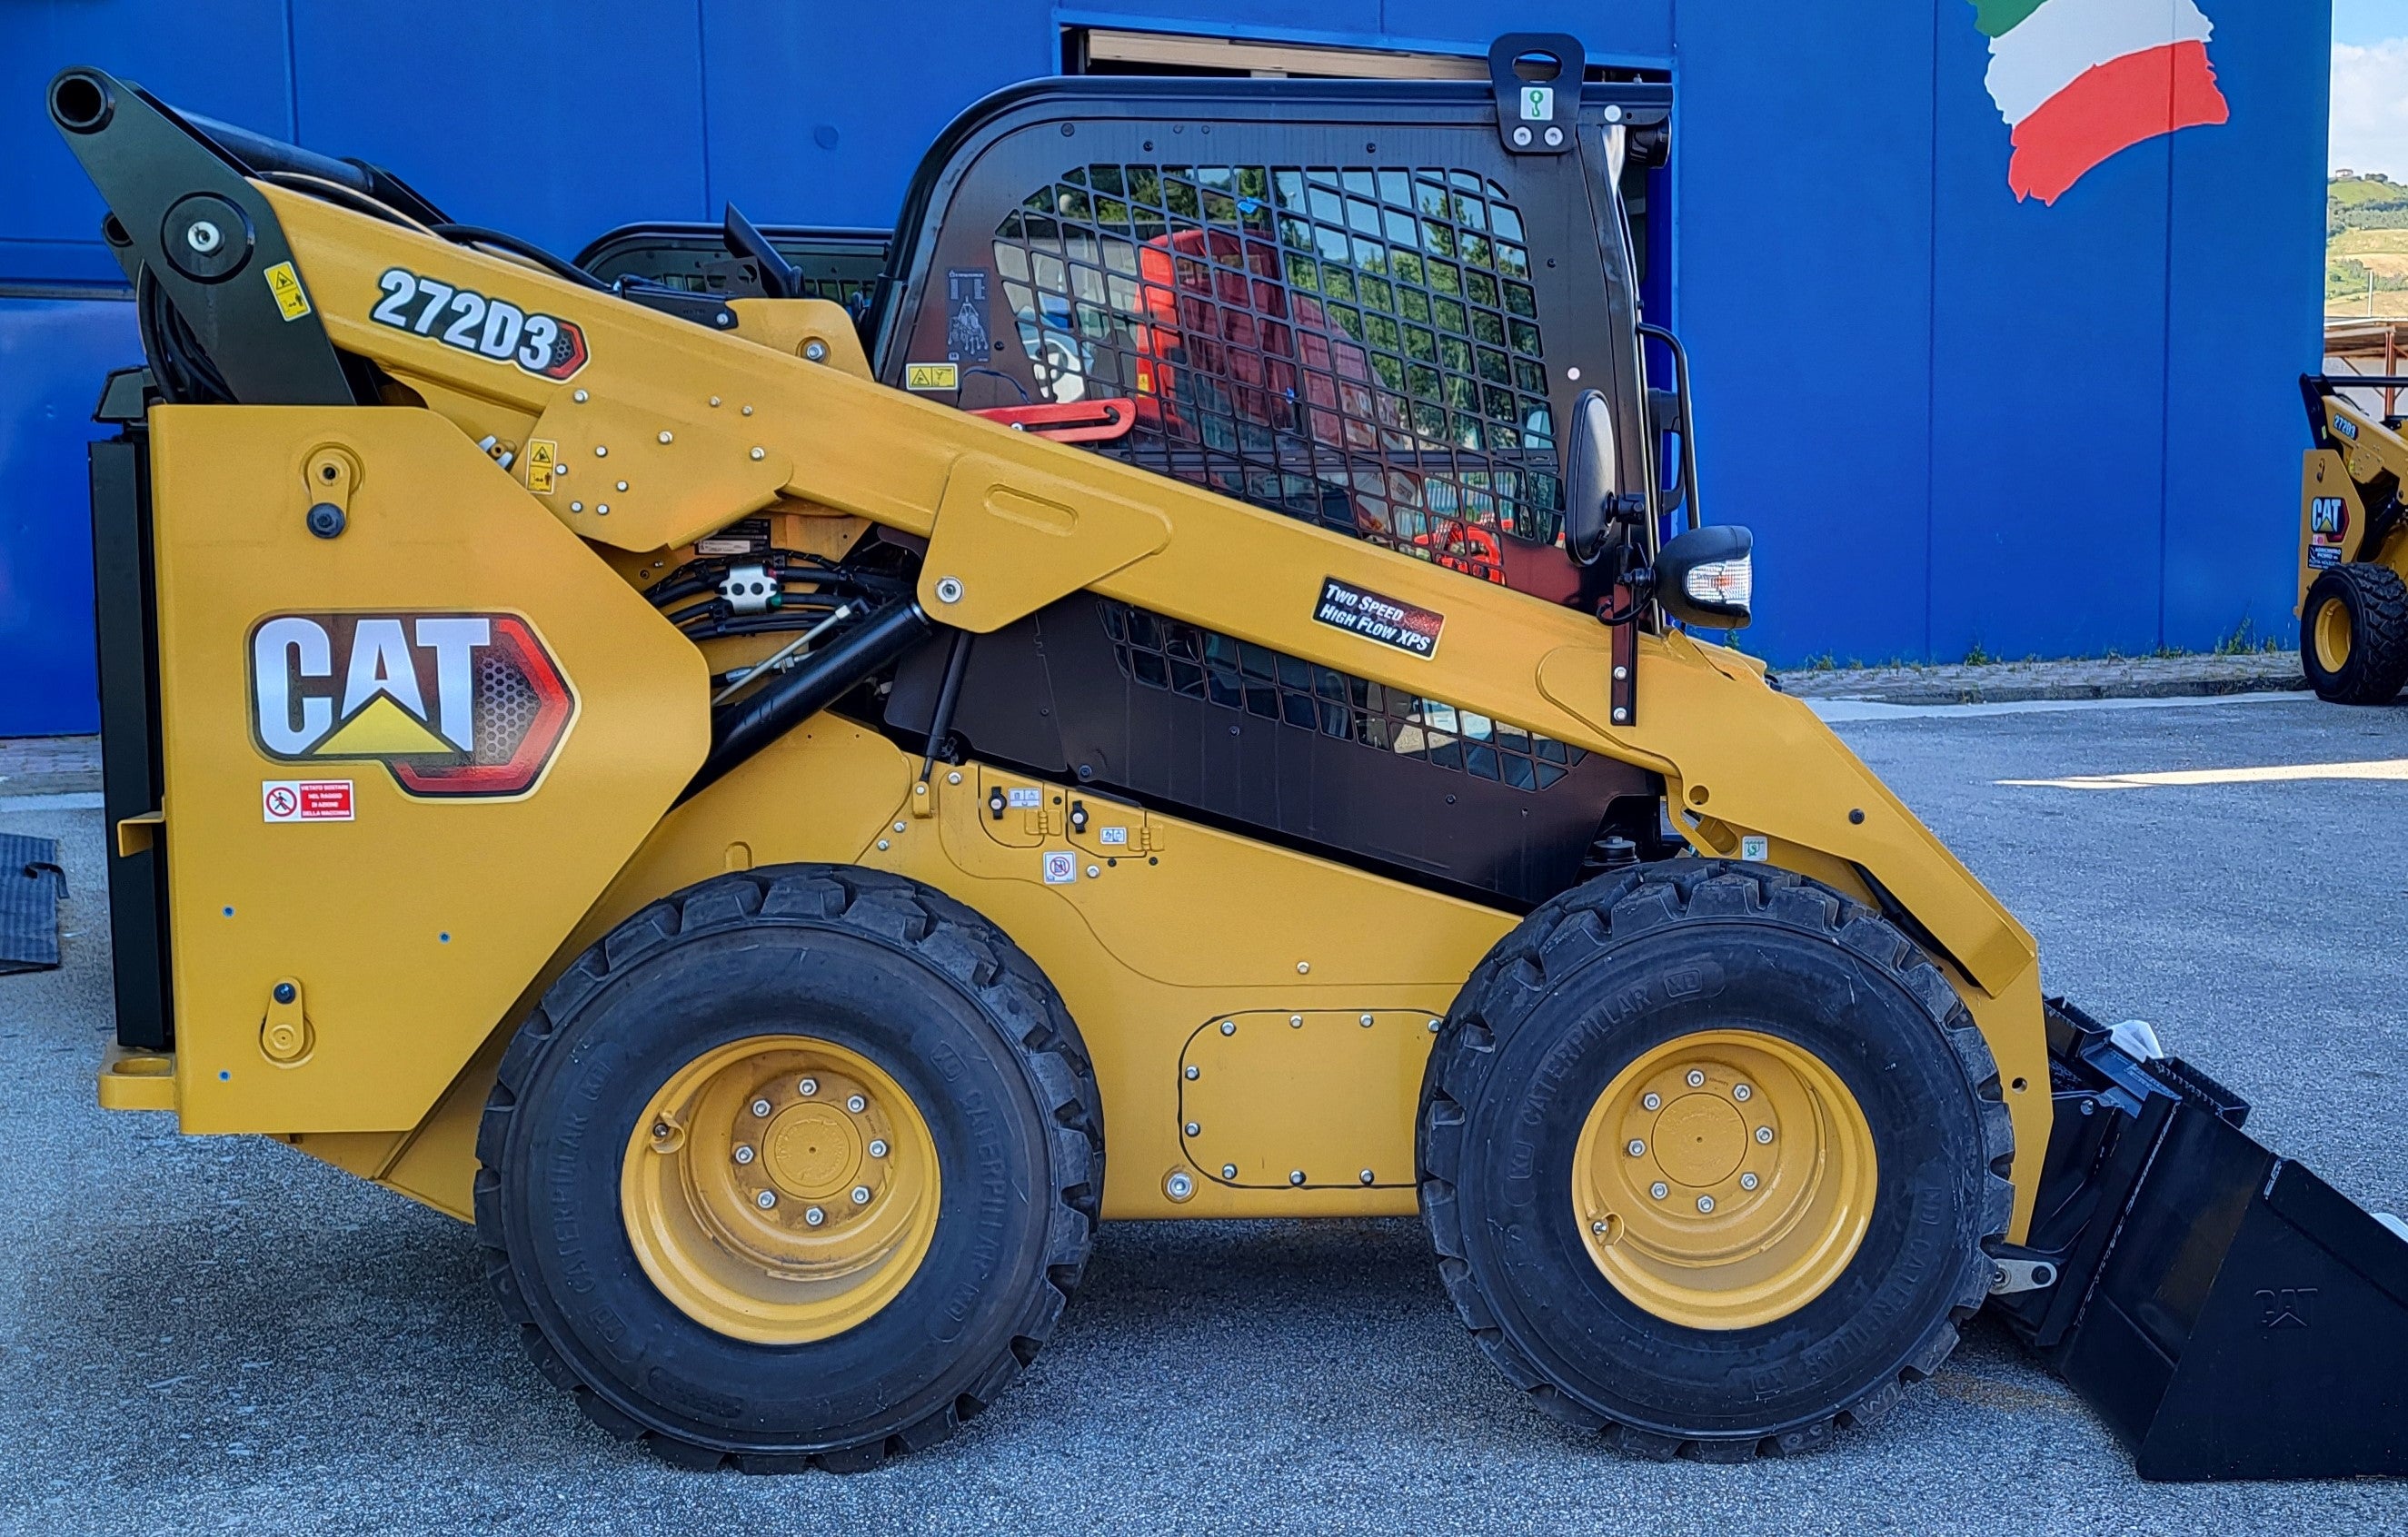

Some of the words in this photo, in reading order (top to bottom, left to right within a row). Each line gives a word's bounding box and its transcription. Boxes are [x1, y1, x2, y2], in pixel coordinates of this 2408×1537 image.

[372, 269, 559, 371] 272D3
[2312, 498, 2342, 532] CAT
[254, 618, 491, 755] CAT
[1396, 630, 1431, 651] XPS
[1522, 986, 1652, 1126] CATERPILLAR
[552, 1114, 596, 1294] CATERPILLAR
[959, 1092, 1008, 1274] CATERPILLAR
[2254, 1288, 2318, 1339] CAT
